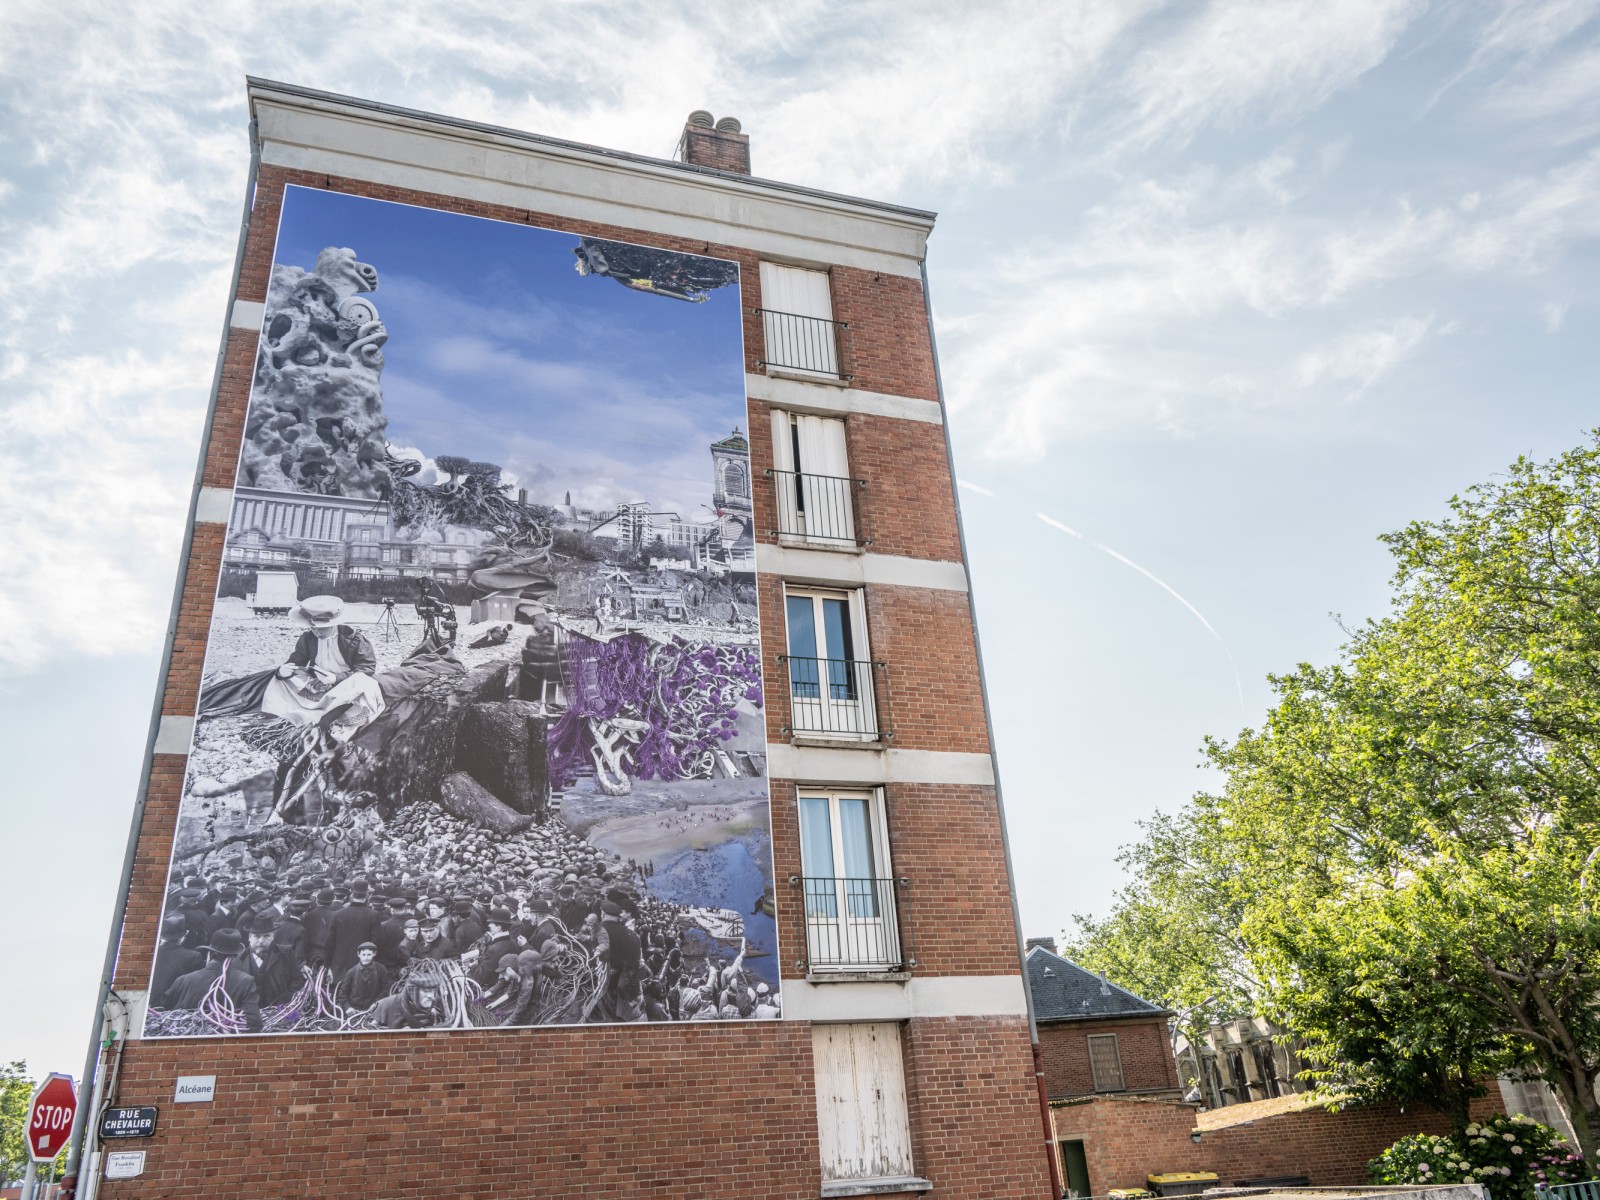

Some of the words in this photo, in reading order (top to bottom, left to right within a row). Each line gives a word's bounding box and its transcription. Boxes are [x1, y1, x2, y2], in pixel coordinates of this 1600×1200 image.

[178, 1084, 212, 1094] Alcéane
[33, 1104, 72, 1130] STOP
[119, 1109, 140, 1119] RUE
[105, 1118, 151, 1129] CHEVALIER
